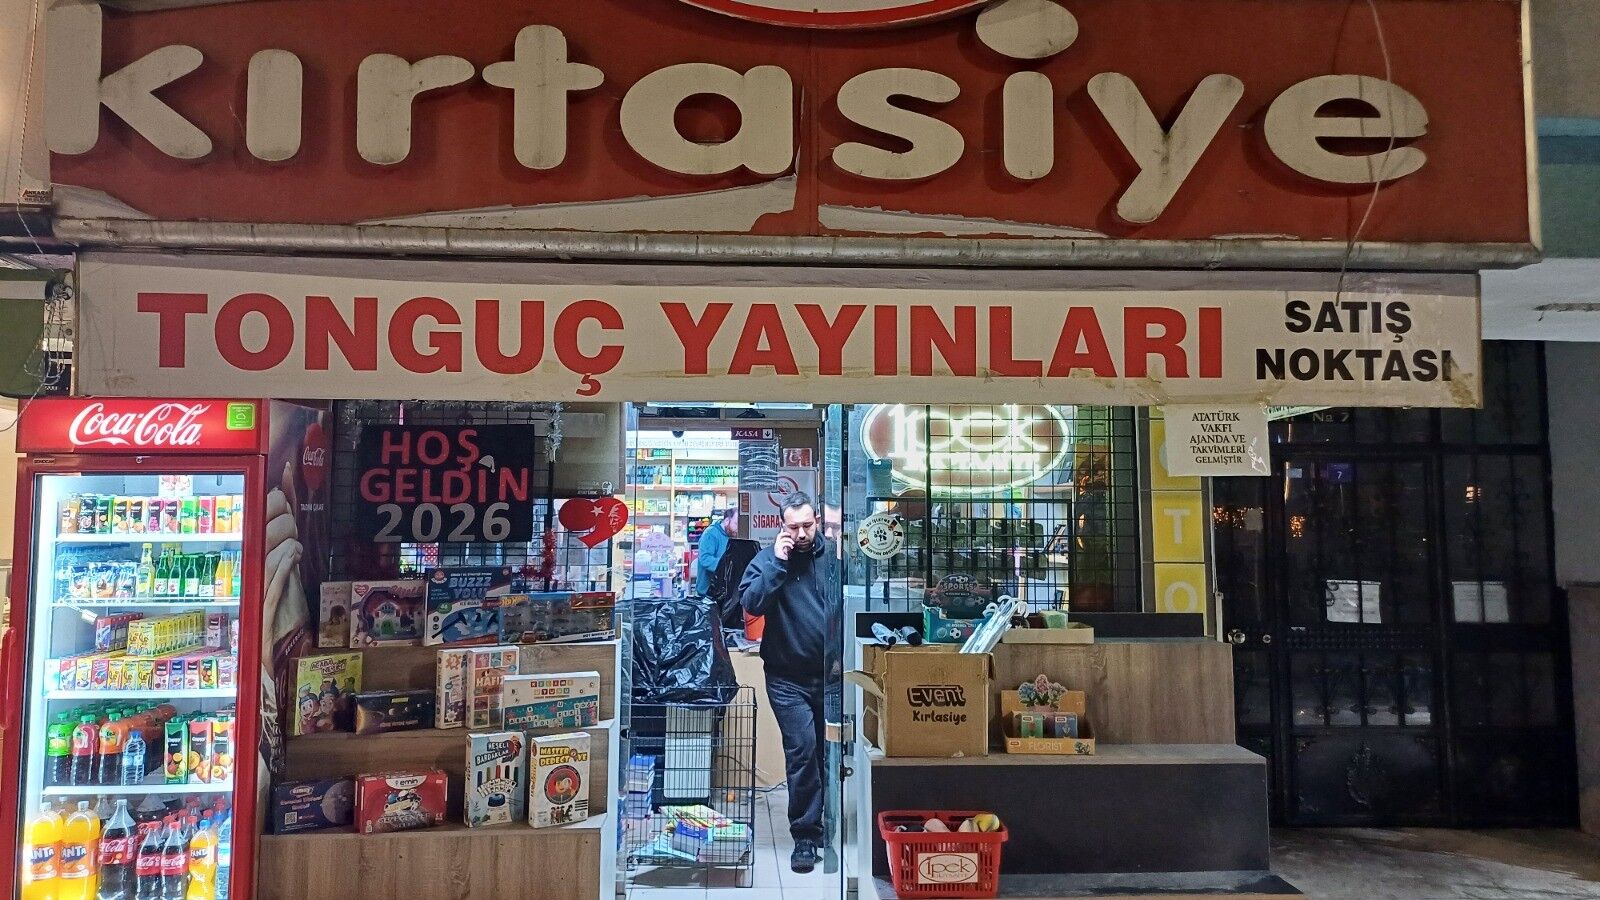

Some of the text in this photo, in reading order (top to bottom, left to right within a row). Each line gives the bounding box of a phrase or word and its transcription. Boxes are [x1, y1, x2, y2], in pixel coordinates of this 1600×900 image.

[46, 0, 1429, 223] kırtasiye
[1285, 300, 1412, 343] SATIŞ
[137, 292, 1223, 396] TONGUÇ YAYINLARI
[1255, 347, 1452, 382] NOKTASI
[1192, 410, 1240, 421] ATATÜRK
[69, 402, 211, 446] Coca-Cola
[1201, 424, 1232, 432] VAKFI
[1190, 435, 1246, 445] AJANDA VE
[381, 429, 480, 472] HOŞ
[1190, 445, 1246, 453] TAKVİMLERİ
[1195, 455, 1243, 465] GELMİŞTİR
[373, 503, 512, 543] 2026
[753, 511, 780, 528] SİGARA
[943, 582, 974, 590] SPORTS
[912, 710, 967, 725] Kırtasiye
[540, 746, 570, 756] MASTER
